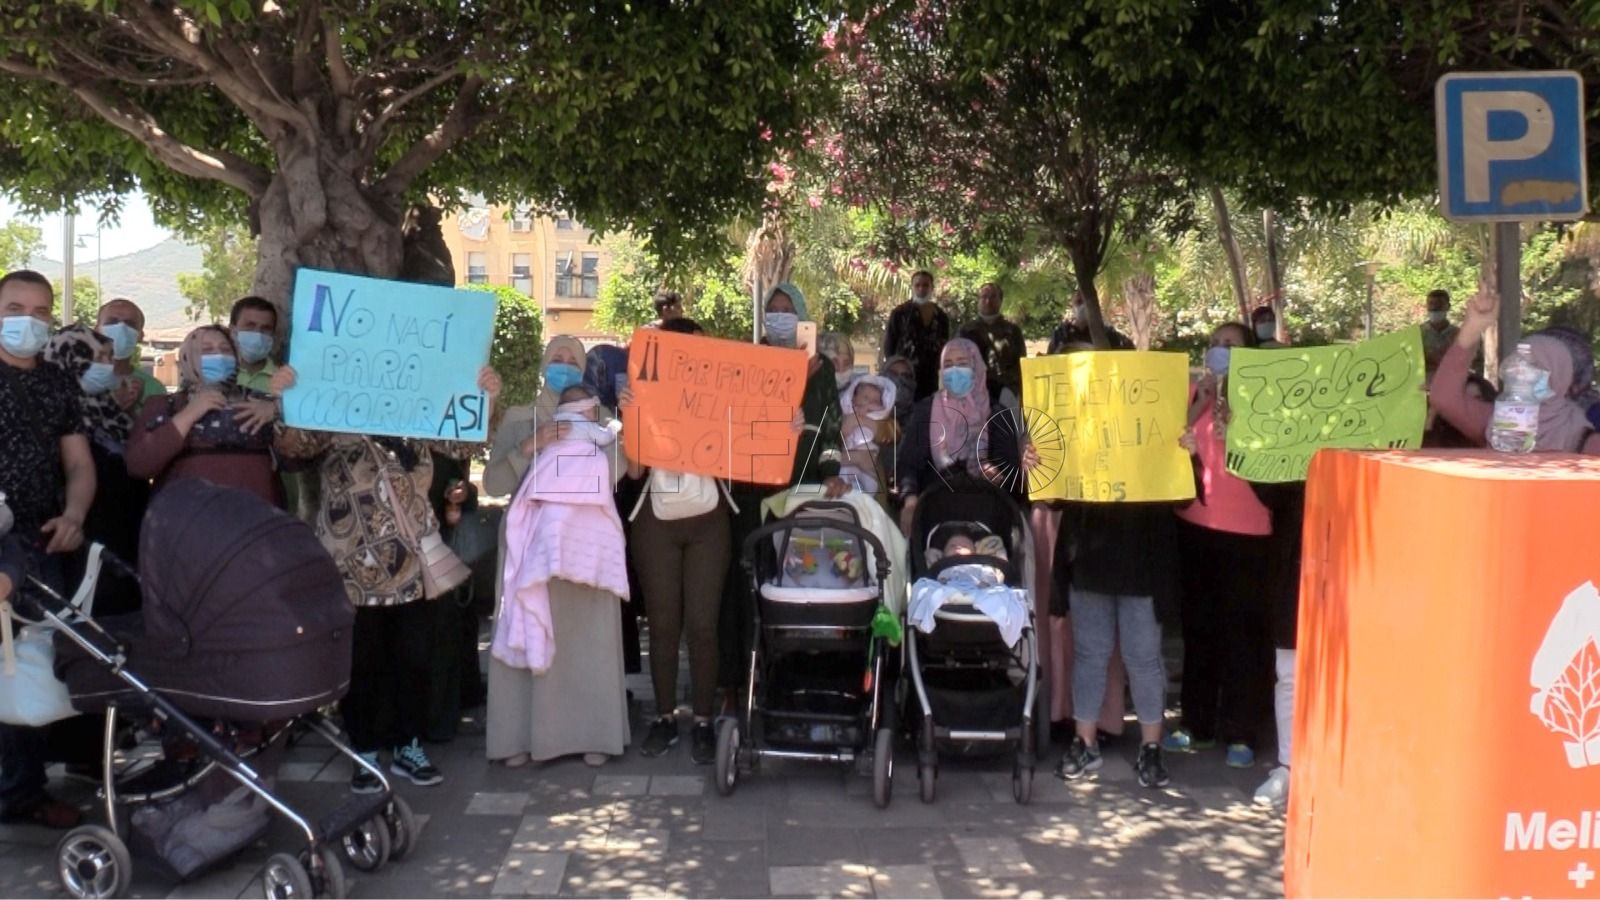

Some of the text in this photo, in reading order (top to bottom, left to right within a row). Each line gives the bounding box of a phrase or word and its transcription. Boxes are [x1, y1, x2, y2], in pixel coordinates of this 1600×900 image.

[1461, 90, 1555, 203] P
[307, 284, 376, 338] NO
[321, 344, 424, 393] PARA
[668, 349, 714, 386] POR
[678, 386, 769, 428] MELILLA
